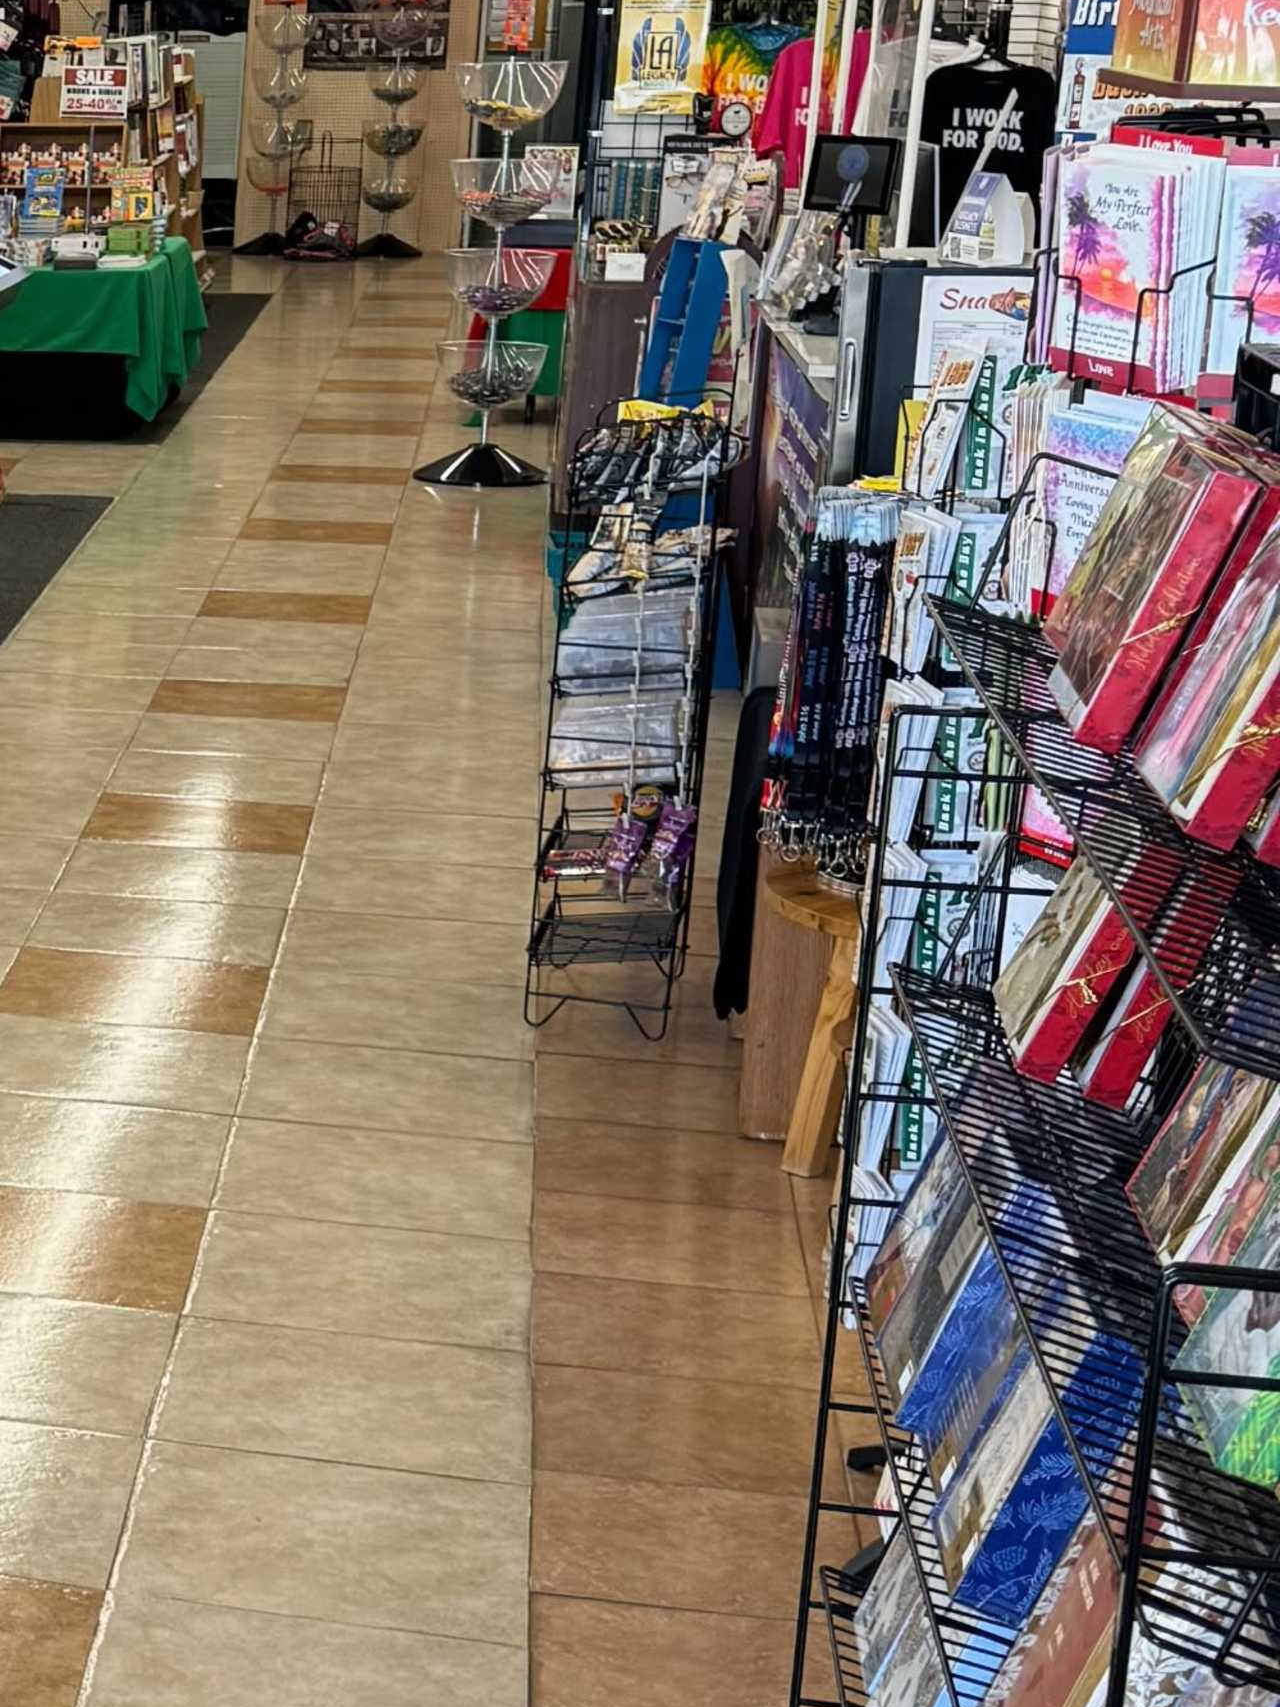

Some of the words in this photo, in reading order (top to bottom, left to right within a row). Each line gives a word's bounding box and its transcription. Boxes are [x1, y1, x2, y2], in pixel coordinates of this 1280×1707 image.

[650, 36, 674, 70] LA
[75, 70, 115, 85] SALE
[952, 107, 958, 126] I
[942, 130, 978, 148] FOR
